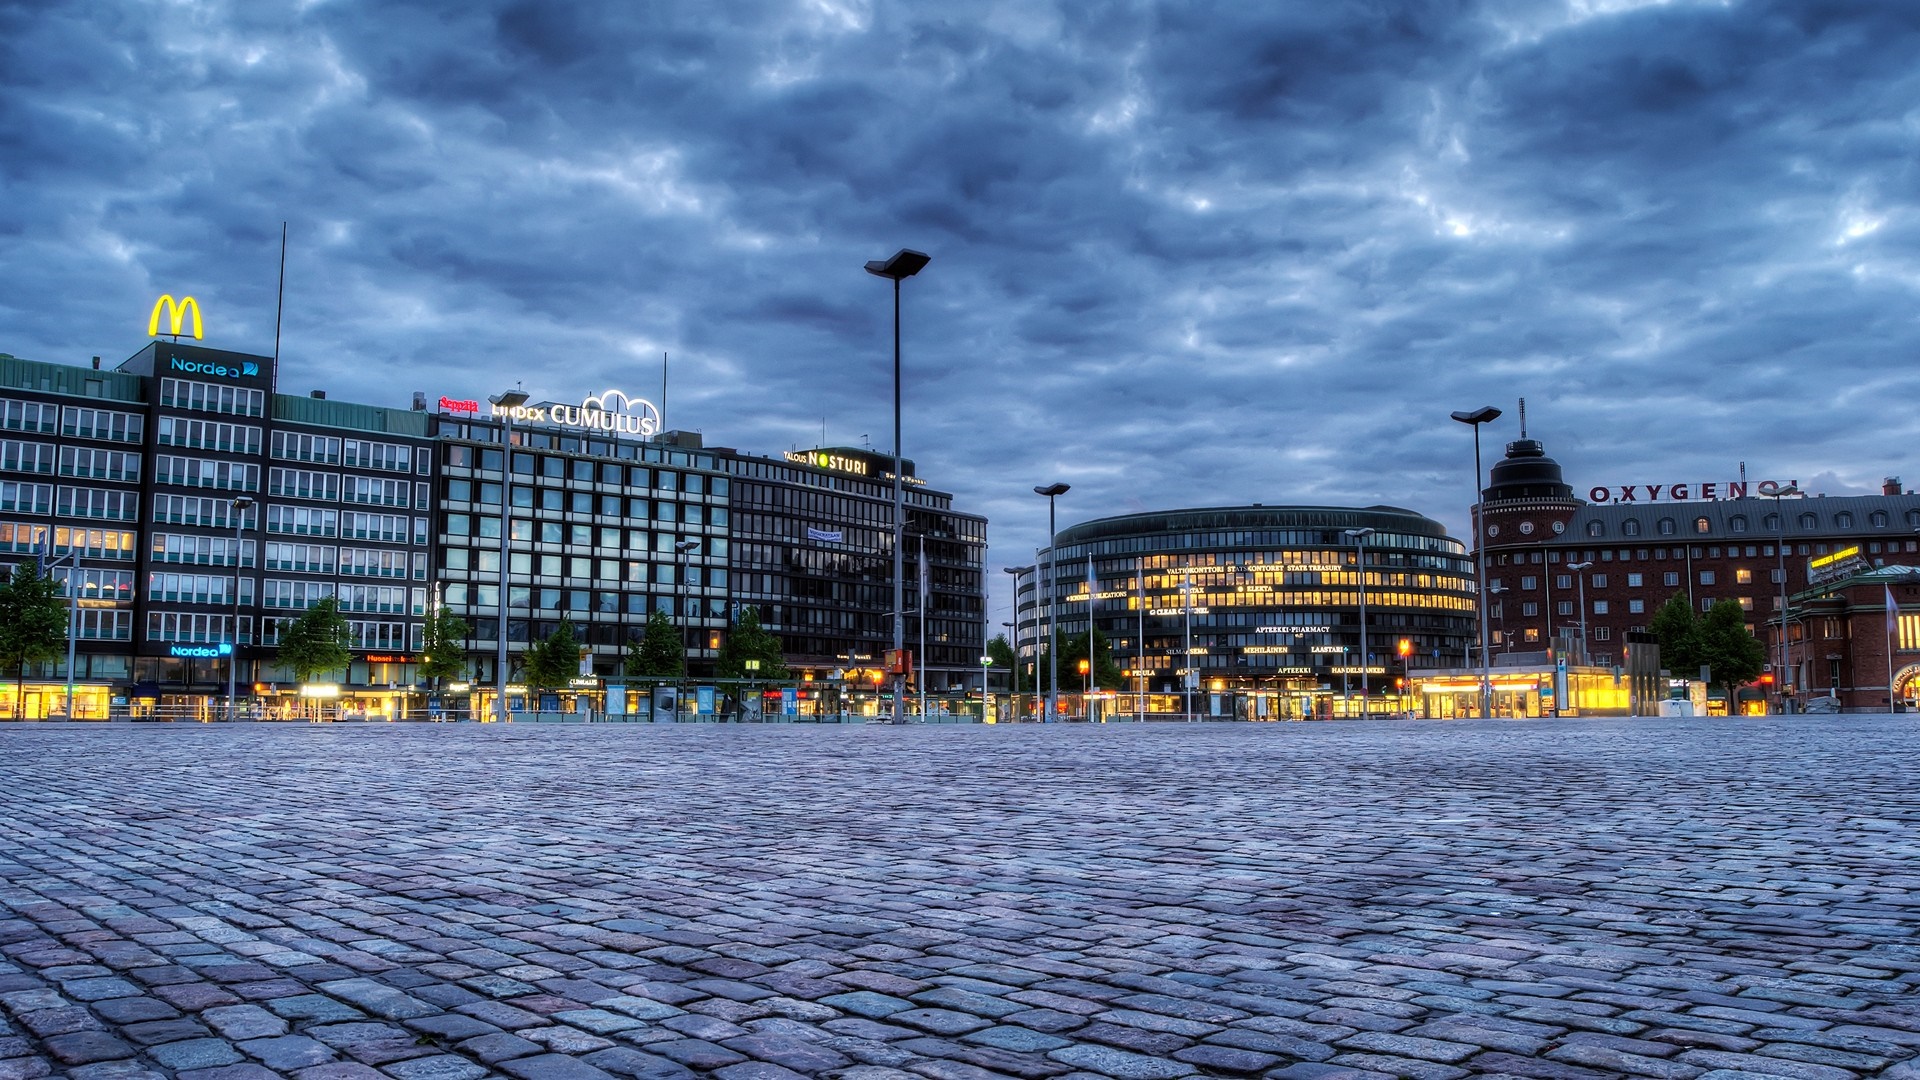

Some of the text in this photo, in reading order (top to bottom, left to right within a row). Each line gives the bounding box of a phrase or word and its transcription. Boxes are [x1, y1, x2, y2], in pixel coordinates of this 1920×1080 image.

[171, 357, 240, 378] Nordea
[440, 396, 478, 413] Seppälä
[550, 404, 654, 436] CUMULUS
[783, 451, 807, 463] TALOUS
[1590, 480, 1804, 503] OXYGENOL
[1166, 566, 1224, 574] VALTIOKONTTORI
[1091, 591, 1127, 599] PUBLICATIONS
[171, 646, 219, 657] Nordea
[1243, 646, 1288, 654] MEHILÄINEN
